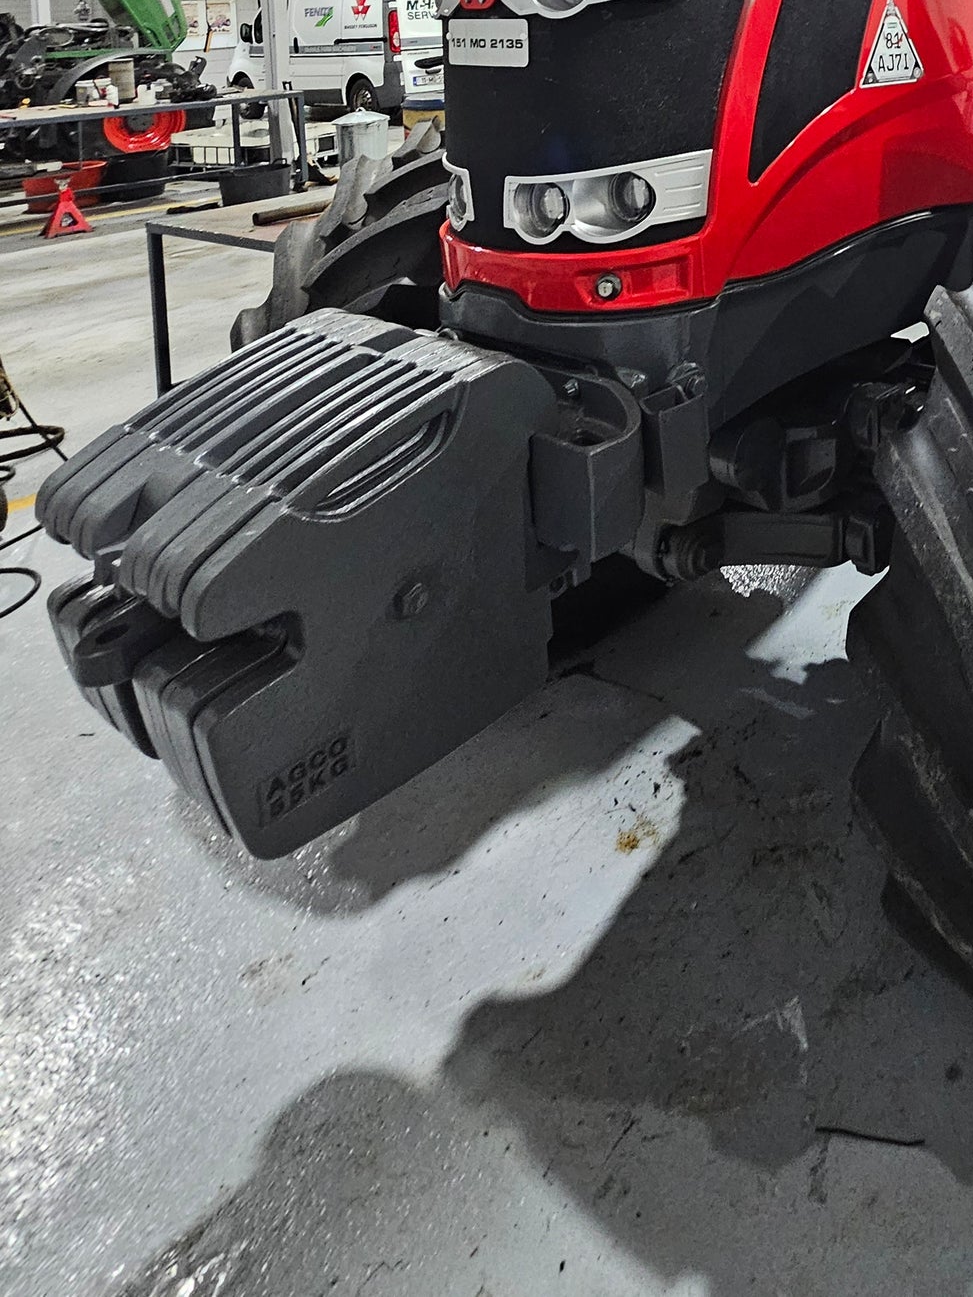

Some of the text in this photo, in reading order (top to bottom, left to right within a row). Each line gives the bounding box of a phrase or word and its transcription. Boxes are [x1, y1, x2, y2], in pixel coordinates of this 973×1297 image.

[451, 37, 524, 49] 151 MO 2135
